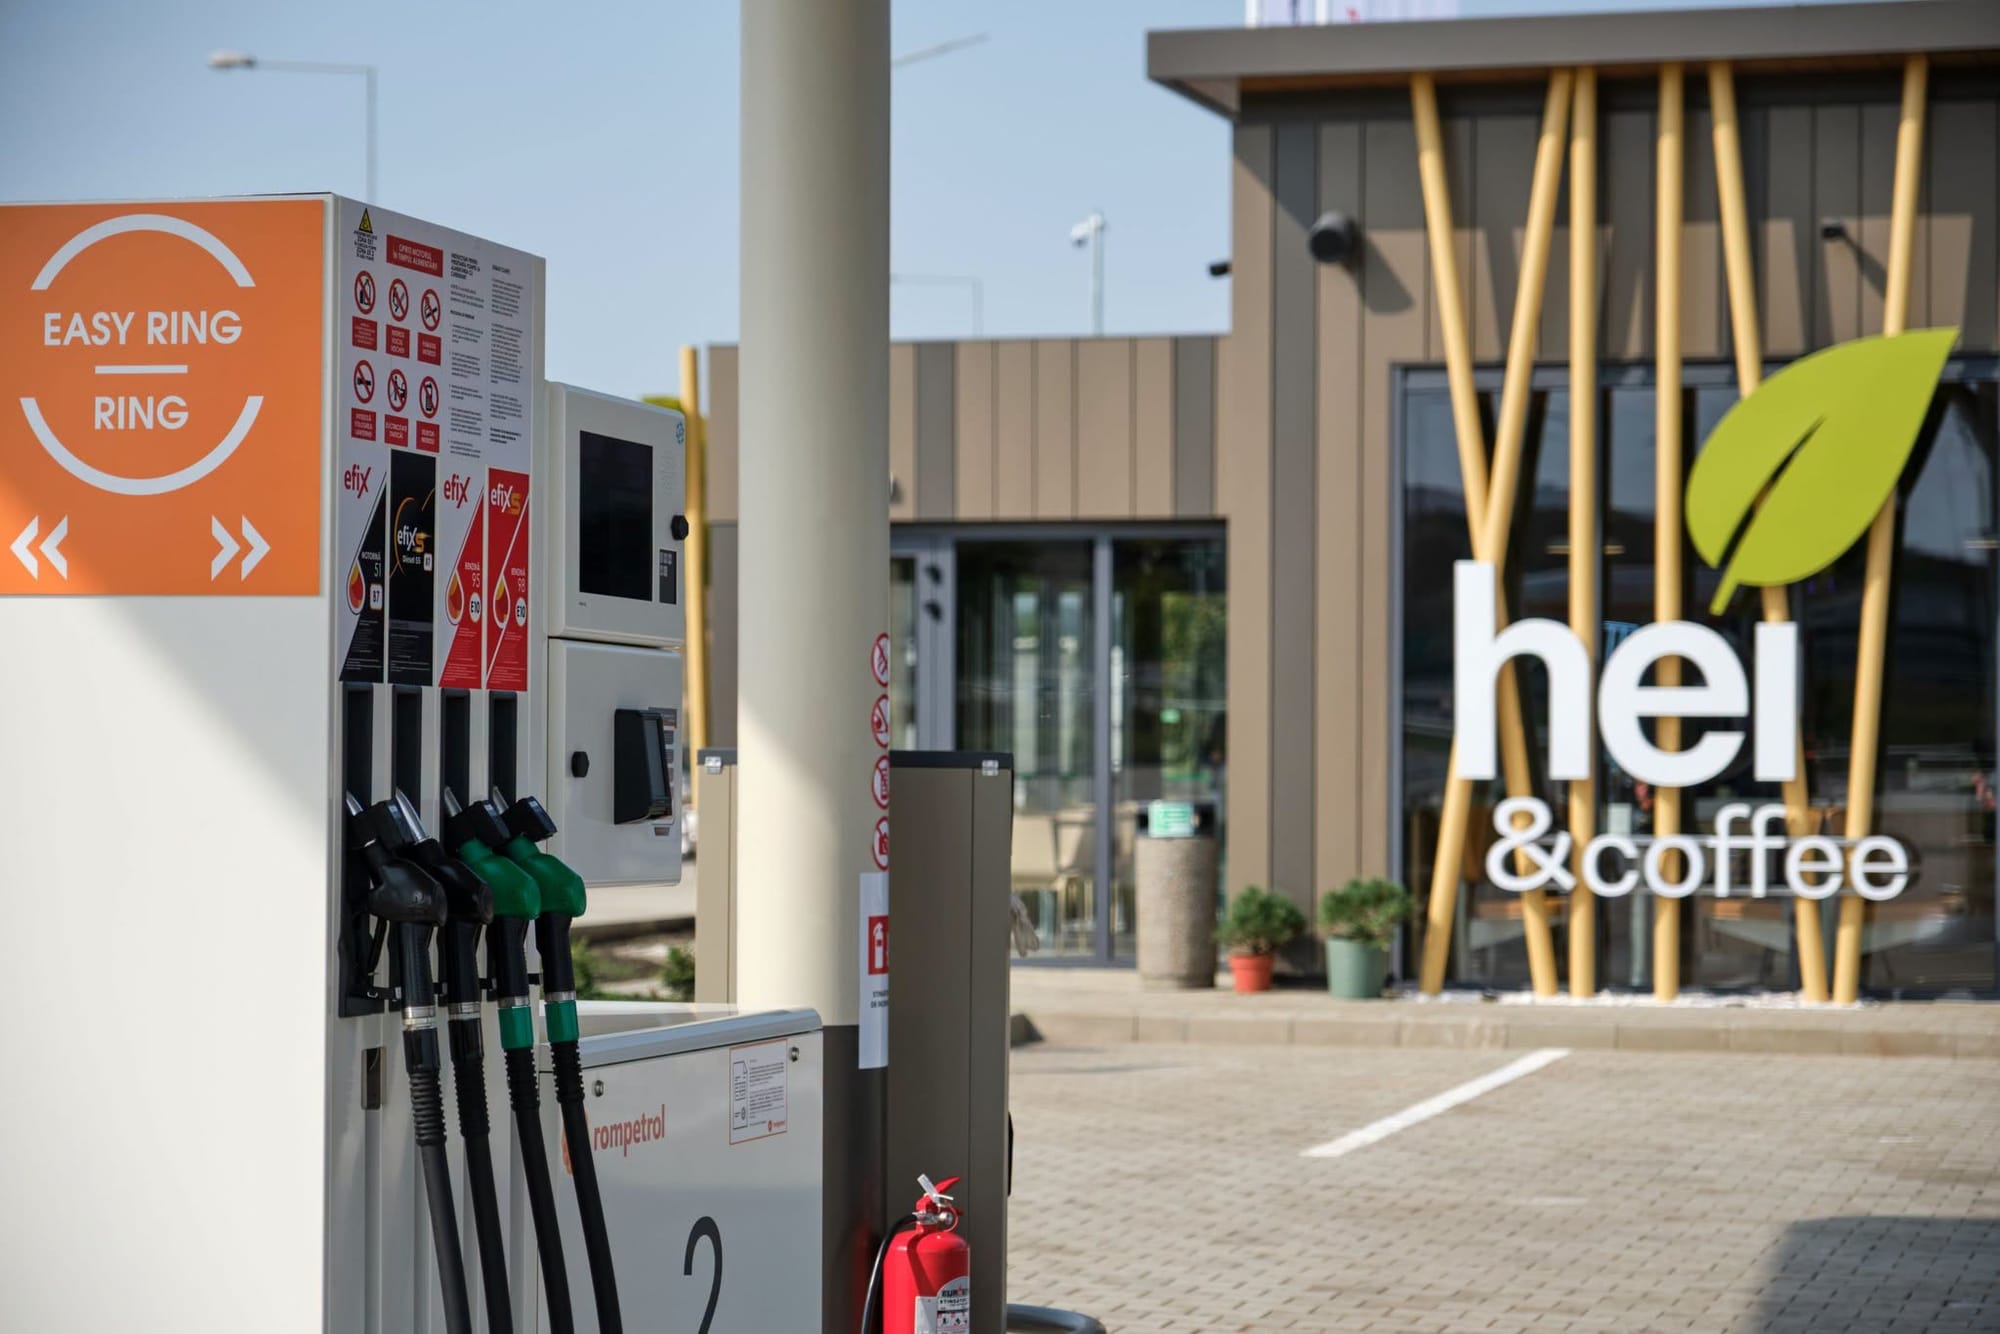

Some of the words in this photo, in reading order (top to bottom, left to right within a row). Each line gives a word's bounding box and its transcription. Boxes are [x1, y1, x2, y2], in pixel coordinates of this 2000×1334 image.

[44, 311, 135, 346] EASY
[147, 310, 242, 345] RING
[94, 395, 189, 430] RING
[343, 463, 371, 499] efix
[443, 473, 471, 509] efix
[374, 562, 382, 578] 51
[472, 573, 480, 588] 95
[517, 578, 526, 593] 98
[470, 600, 480, 614] E10
[516, 604, 526, 618] E10
[1454, 559, 1798, 787] hei
[593, 1103, 665, 1158] rompetrol
[684, 1216, 723, 1334] 2
